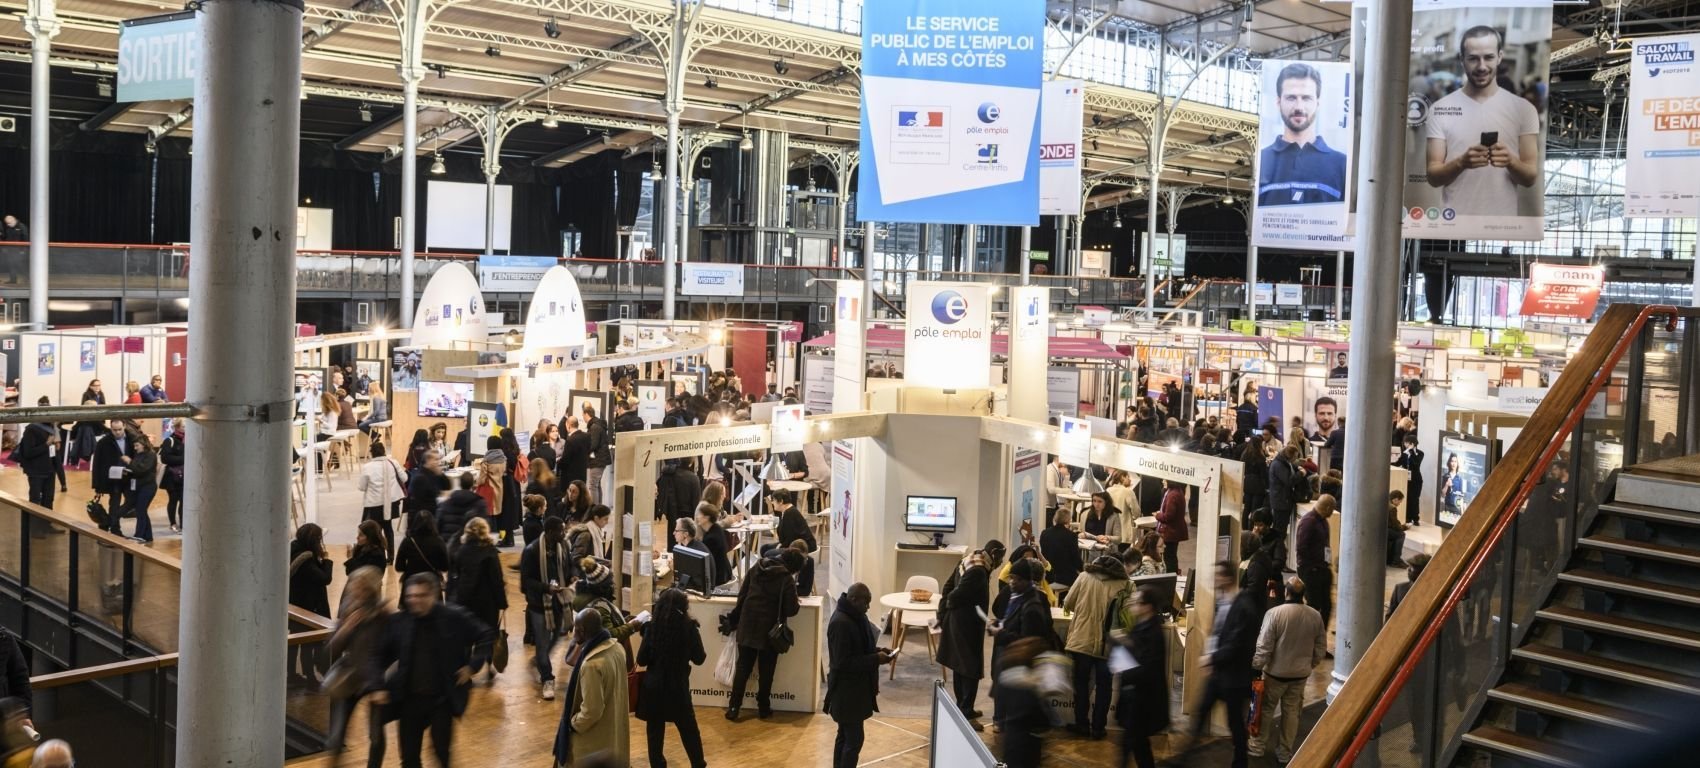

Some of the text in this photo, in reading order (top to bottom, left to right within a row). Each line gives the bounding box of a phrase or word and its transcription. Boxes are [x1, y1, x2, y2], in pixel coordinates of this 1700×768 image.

[907, 16, 999, 31] LE SERVICE
[871, 34, 1034, 50] PUBLIC DE L'EMPLOI
[1423, 45, 1445, 53] profil
[1638, 44, 1676, 54] SALON
[118, 32, 195, 85] SORTIE
[897, 49, 1006, 68] À MES CÔTÉS
[1646, 52, 1692, 62] TRAVAIL
[1645, 100, 1664, 113] JE
[966, 126, 982, 134] pôle
[1040, 145, 1073, 158] ONDE
[914, 326, 982, 340] pôle emploi
[664, 435, 761, 452] Formation professionnelle
[1139, 457, 1195, 477] Droit du travail
[690, 688, 724, 696] rmation
[1052, 699, 1075, 708] Droit
